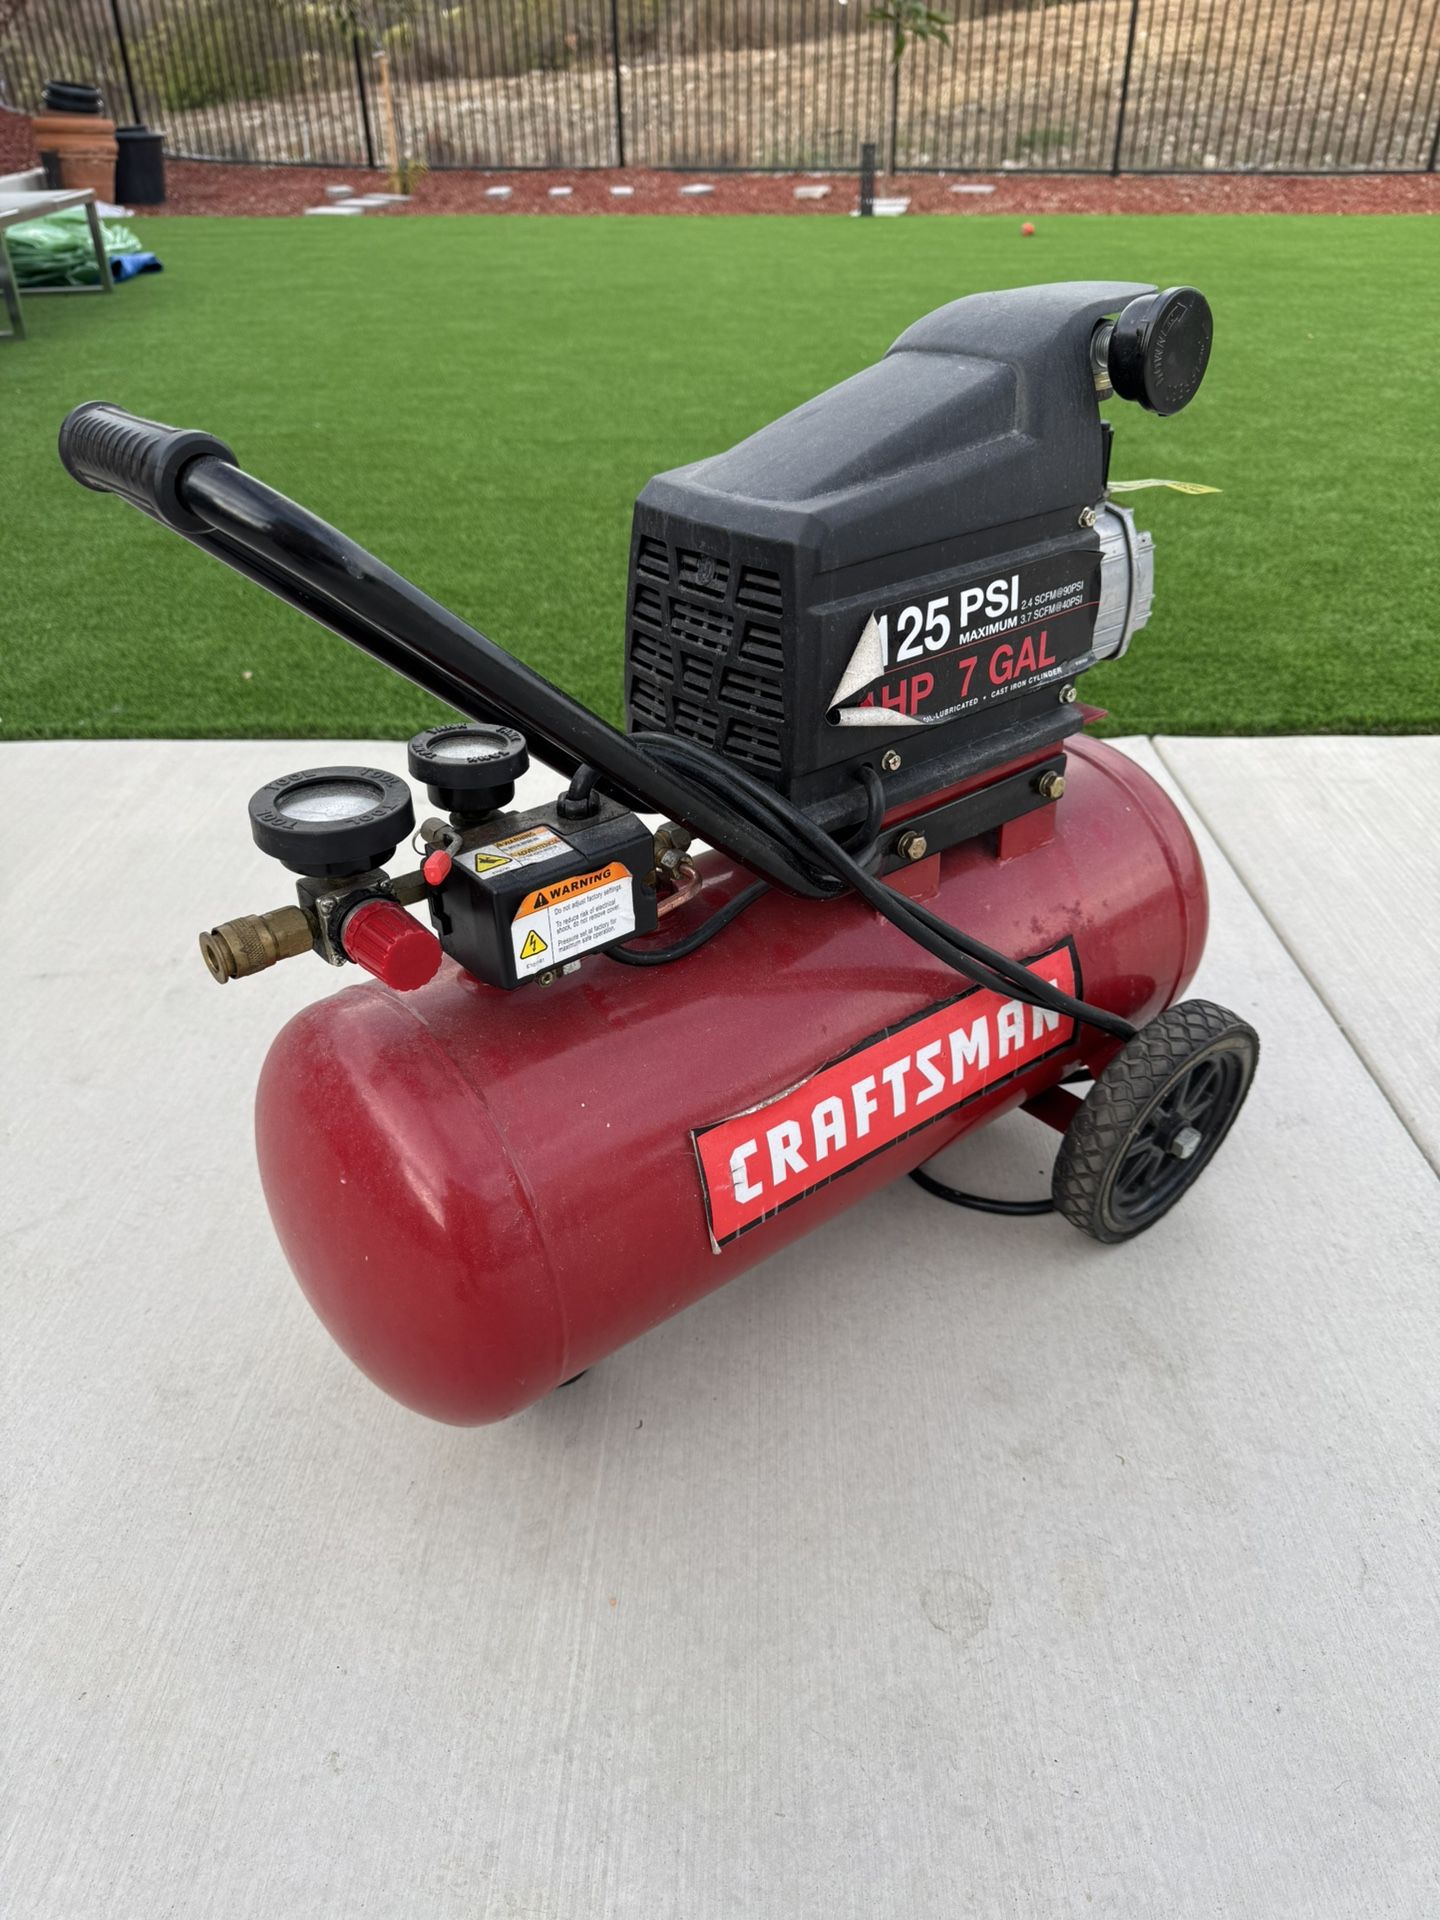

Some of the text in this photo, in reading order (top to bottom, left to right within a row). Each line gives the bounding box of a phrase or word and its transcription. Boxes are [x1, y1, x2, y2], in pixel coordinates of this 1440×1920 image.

[960, 575, 1020, 628] PSI
[1021, 580, 1084, 610] 2.4 SCFM@90PSI
[1019, 594, 1083, 625] 3.7 SCFM@40PSI
[959, 615, 1018, 645] MAXIMUM
[958, 656, 978, 698] 7
[988, 630, 1056, 685] GAL
[991, 687, 1009, 698] CAST
[1010, 679, 1027, 691] IRON
[1028, 666, 1062, 684] CYLINDER
[264, 771, 316, 792] TOOL
[360, 768, 402, 788] TOOL
[257, 809, 298, 830] TOOL
[345, 802, 396, 827] TOOL
[550, 869, 611, 899] WARNING
[554, 907, 562, 915] Do
[572, 898, 586, 909] adjust
[587, 892, 602, 902] factory
[563, 914, 579, 924] reduce
[580, 910, 588, 918] risk
[595, 898, 616, 911] electrical
[580, 916, 588, 924] not
[589, 910, 606, 920] remove
[558, 934, 579, 947] Pressure
[594, 921, 610, 932] factory
[559, 939, 581, 952] maximum
[582, 935, 592, 943] safe
[730, 978, 1061, 1204] CRAFTSMAN
